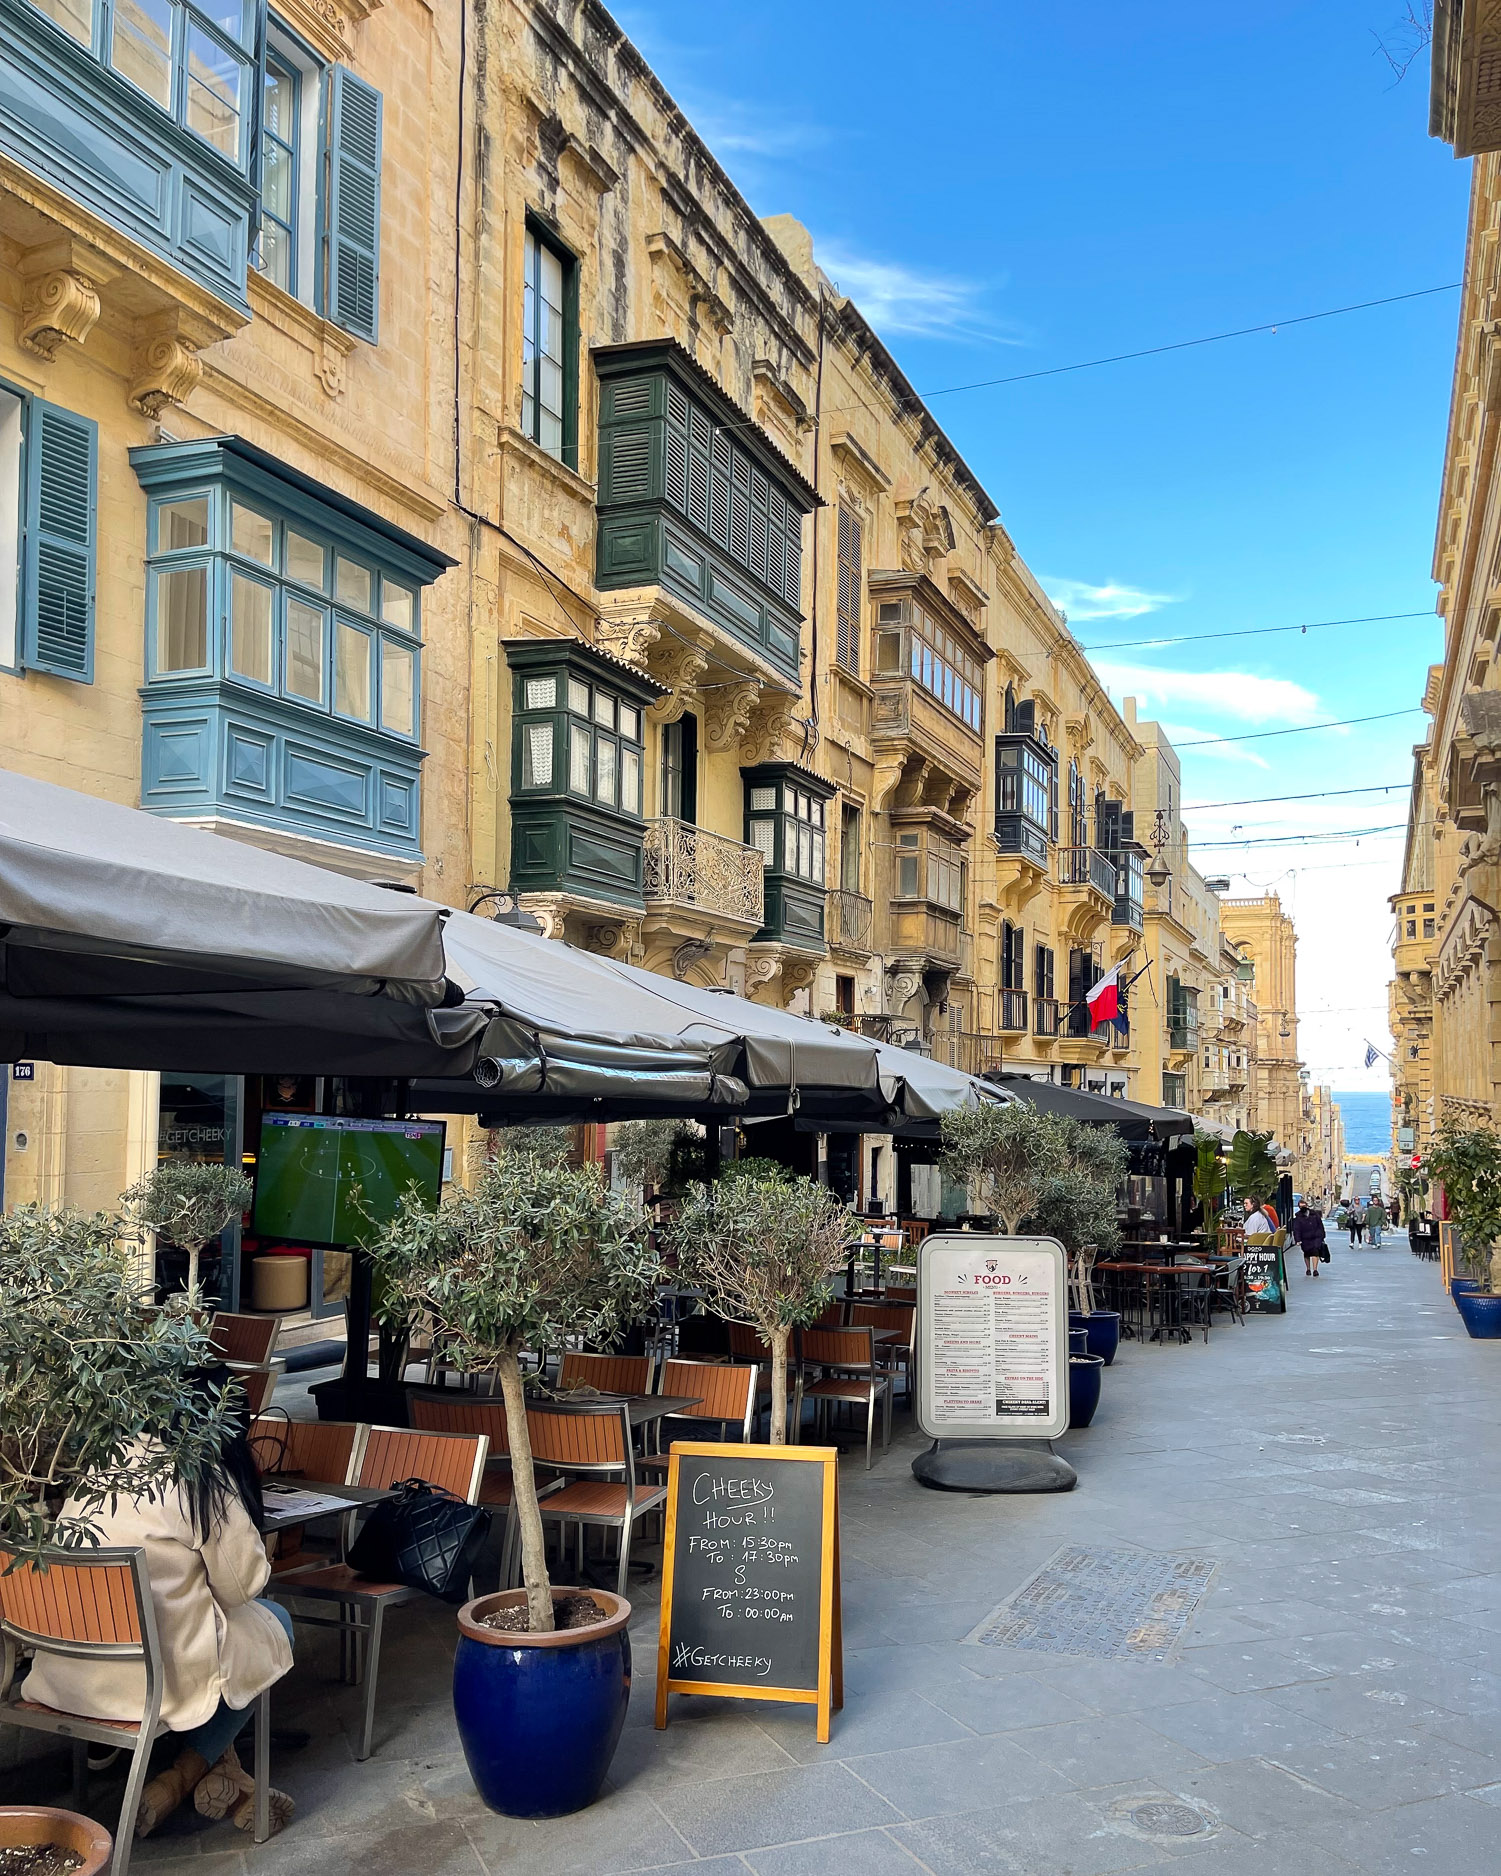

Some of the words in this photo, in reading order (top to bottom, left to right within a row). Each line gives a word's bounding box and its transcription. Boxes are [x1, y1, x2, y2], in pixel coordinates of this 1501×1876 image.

[15, 1066, 31, 1077] 176
[159, 1128, 232, 1143] #GETCHEEKY
[1259, 1252, 1276, 1262] HOUR
[1263, 1264, 1269, 1273] 1
[974, 1275, 1012, 1285] FOOD
[692, 1472, 774, 1510] CHEEKY
[703, 1511, 757, 1530] HOUR
